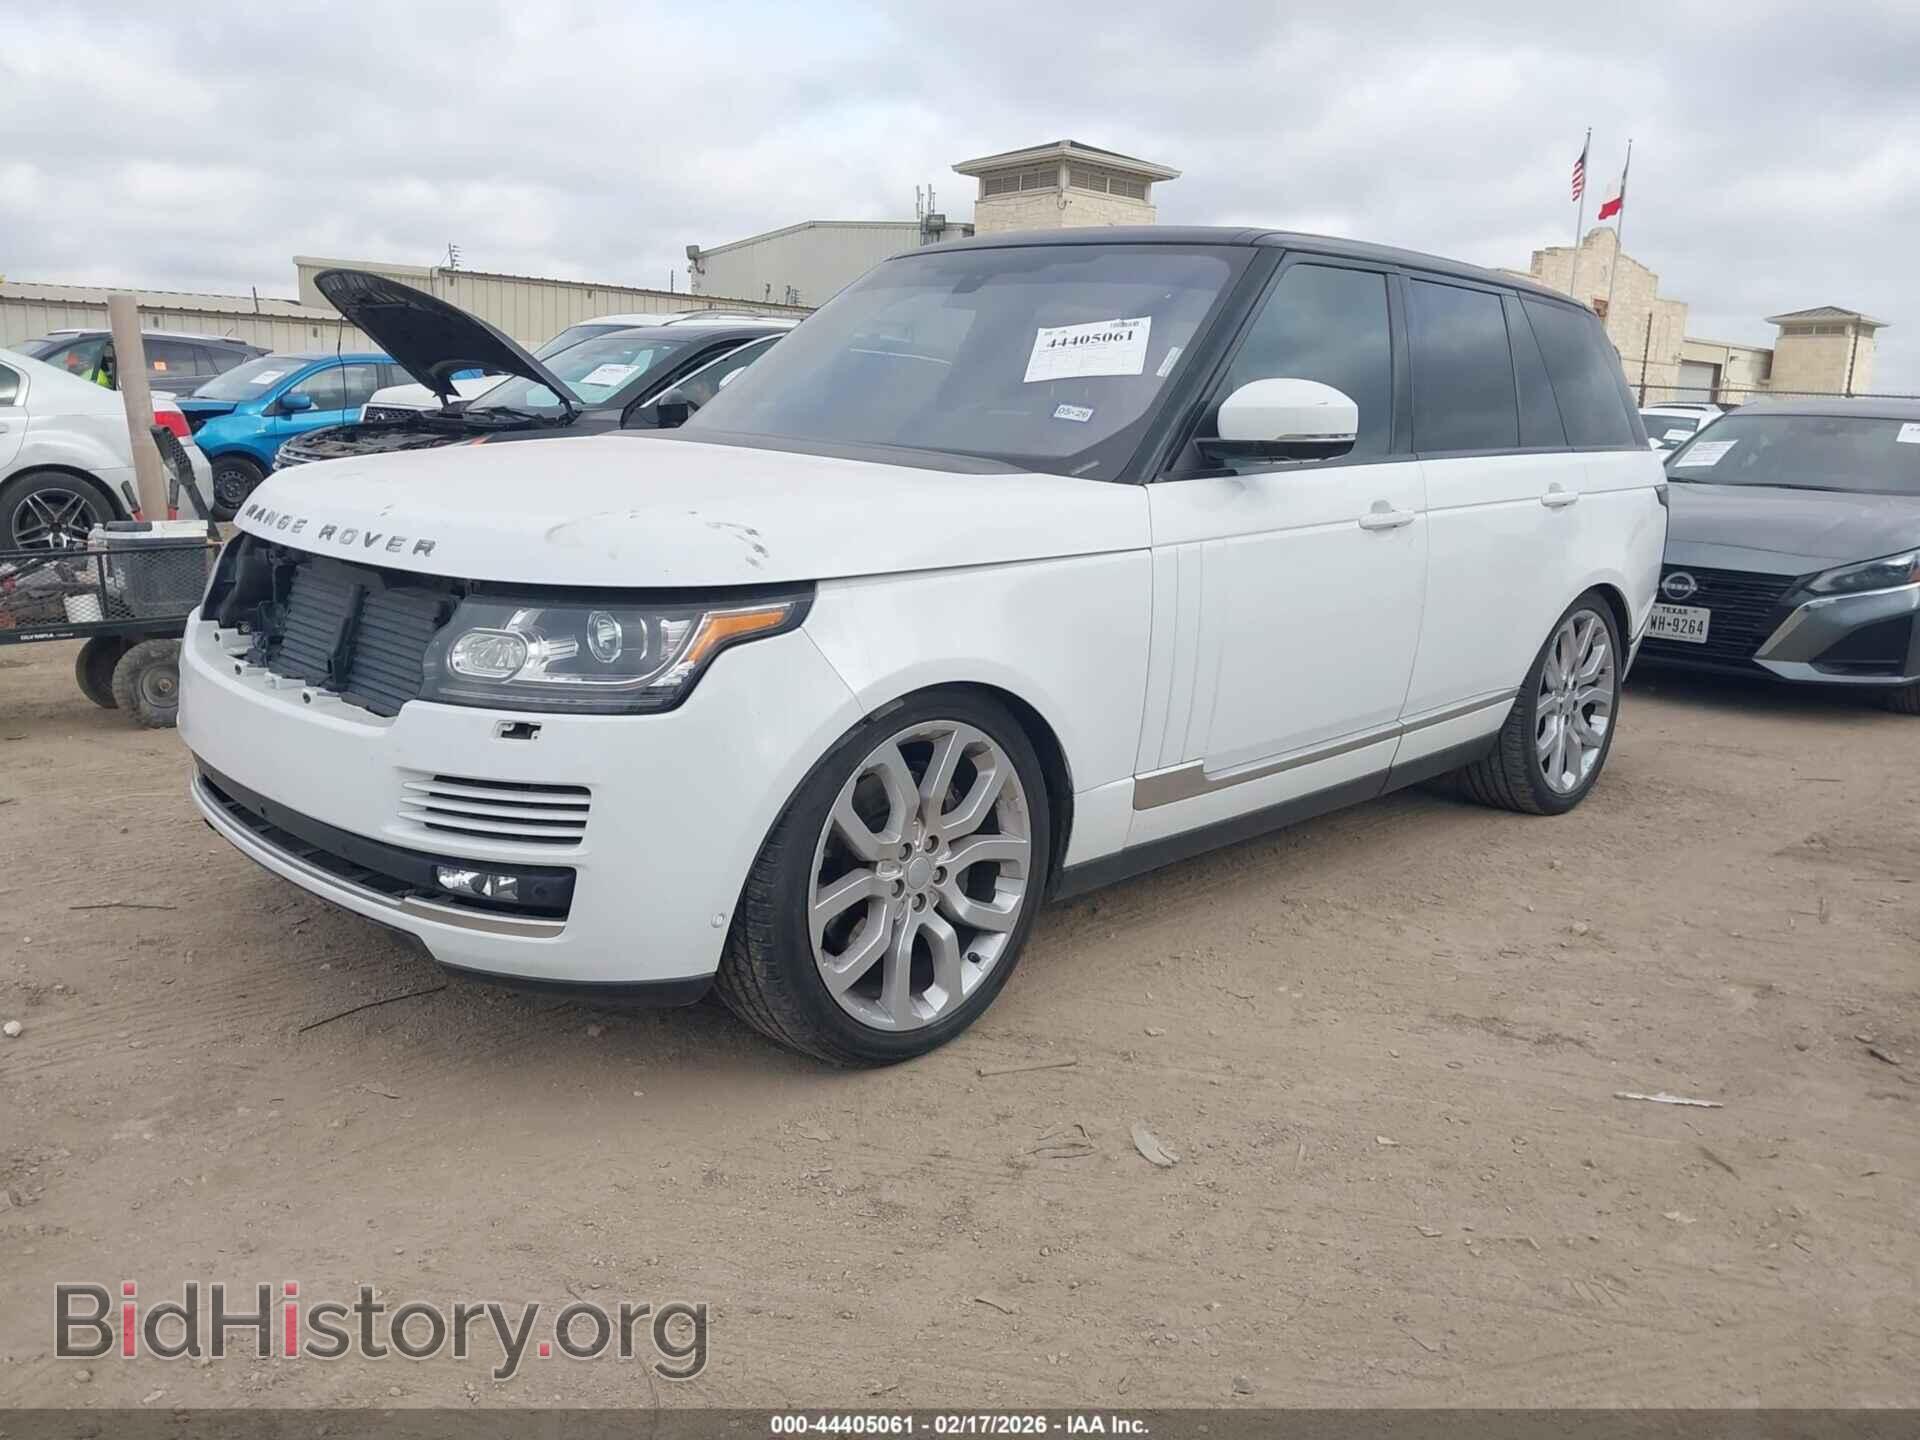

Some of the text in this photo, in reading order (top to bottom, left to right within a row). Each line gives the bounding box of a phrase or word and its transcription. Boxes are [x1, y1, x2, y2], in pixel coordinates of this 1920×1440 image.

[1047, 330, 1134, 348] 44405061
[245, 504, 436, 558] RANGE ROVER
[1661, 606, 1689, 615] TEXAS
